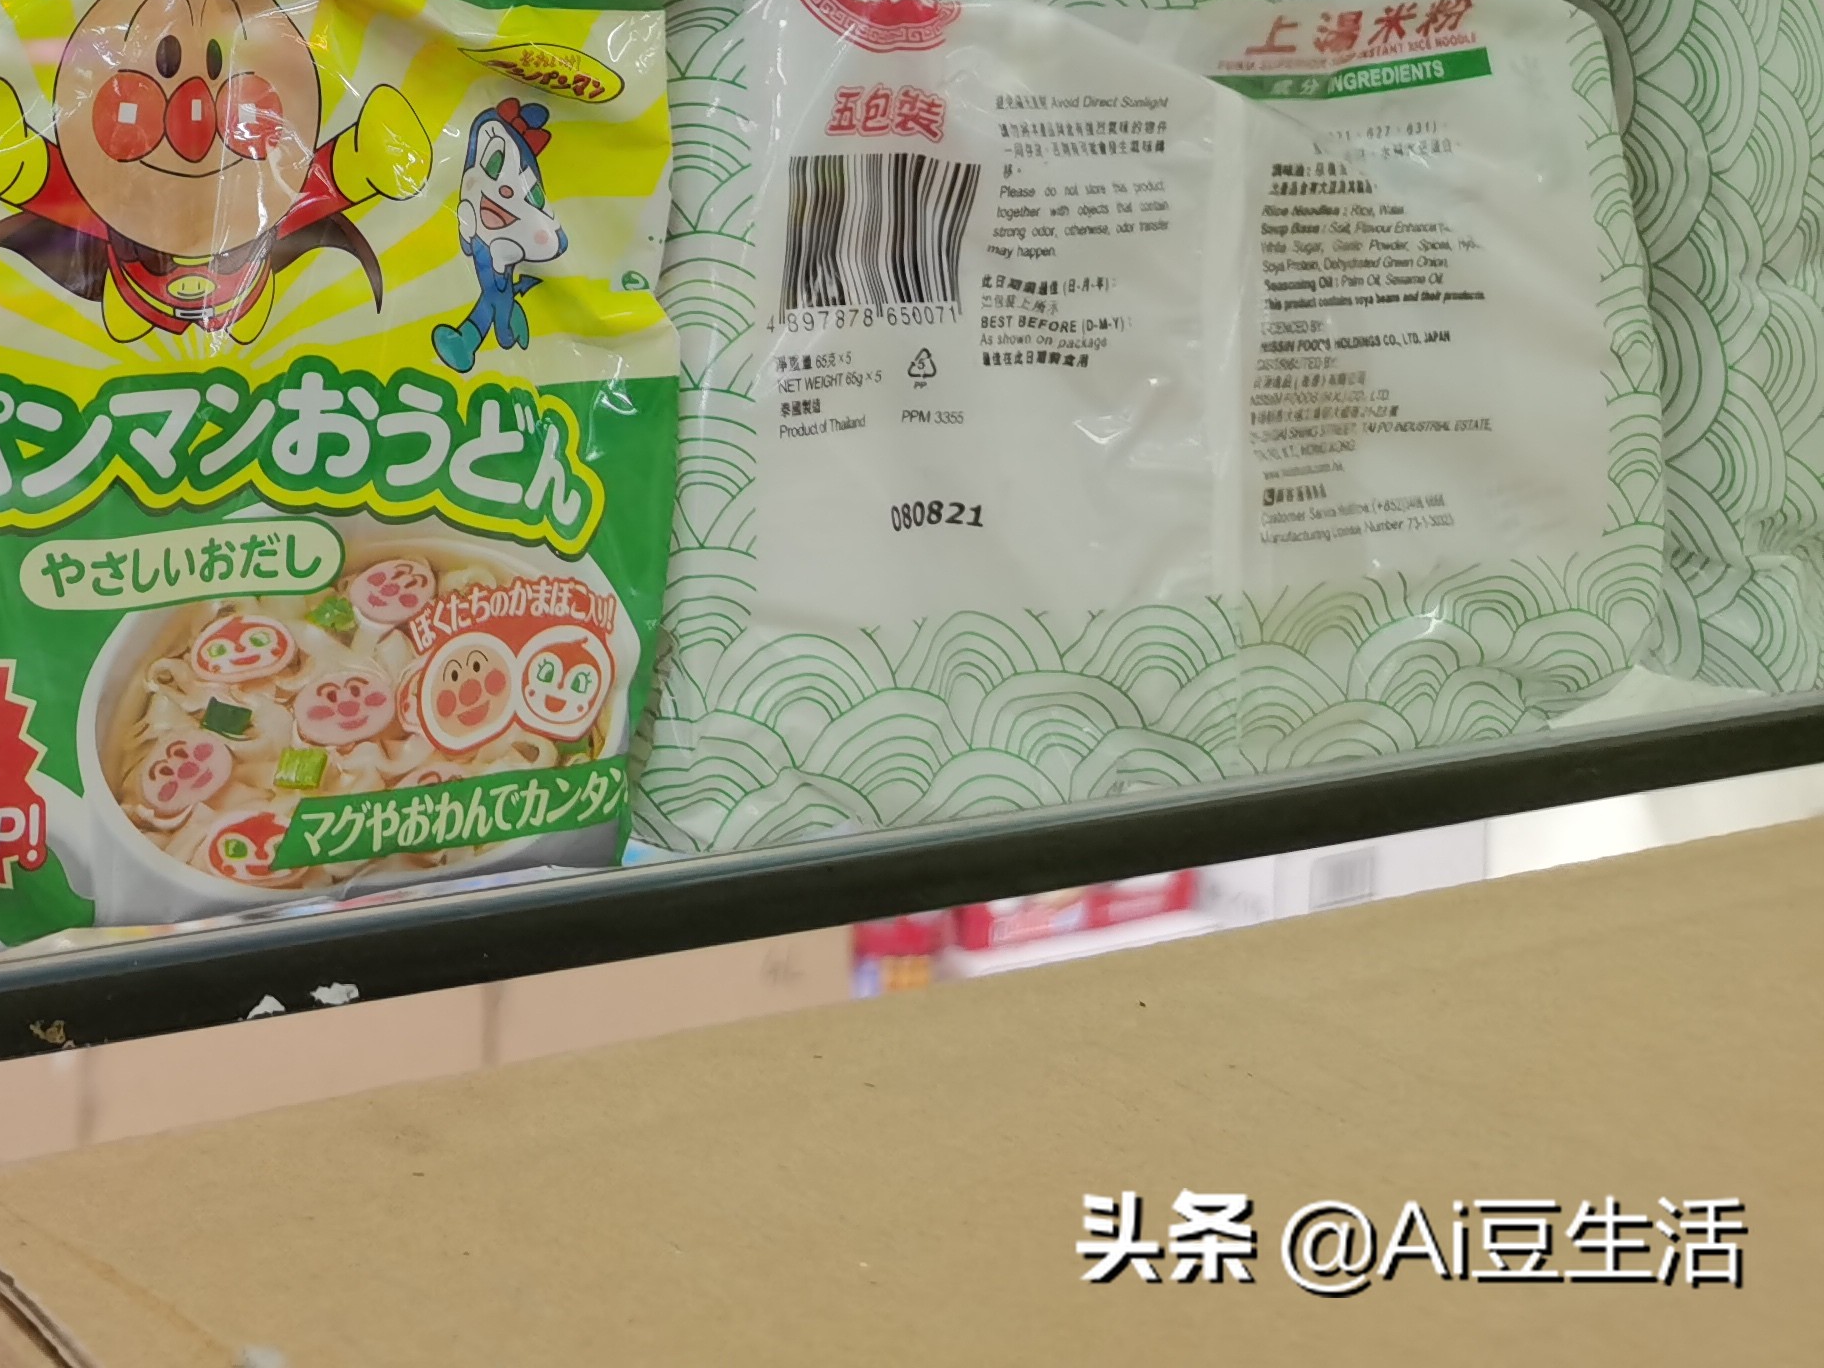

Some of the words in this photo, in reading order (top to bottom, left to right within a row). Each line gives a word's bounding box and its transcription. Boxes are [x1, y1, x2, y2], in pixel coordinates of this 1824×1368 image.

[786, 306, 878, 334] 897878
[886, 304, 960, 328] 650071
[980, 315, 1013, 330] BEST
[1017, 315, 1078, 334] BEFORE
[979, 333, 994, 347] As
[996, 332, 1032, 346] shown
[1035, 333, 1054, 347] on
[777, 376, 802, 395] NET
[900, 407, 932, 425] PPM
[933, 409, 965, 426] 3355
[778, 420, 820, 440] Product
[890, 499, 984, 533] 080821
[41, 533, 323, 599] やさしいおだし
